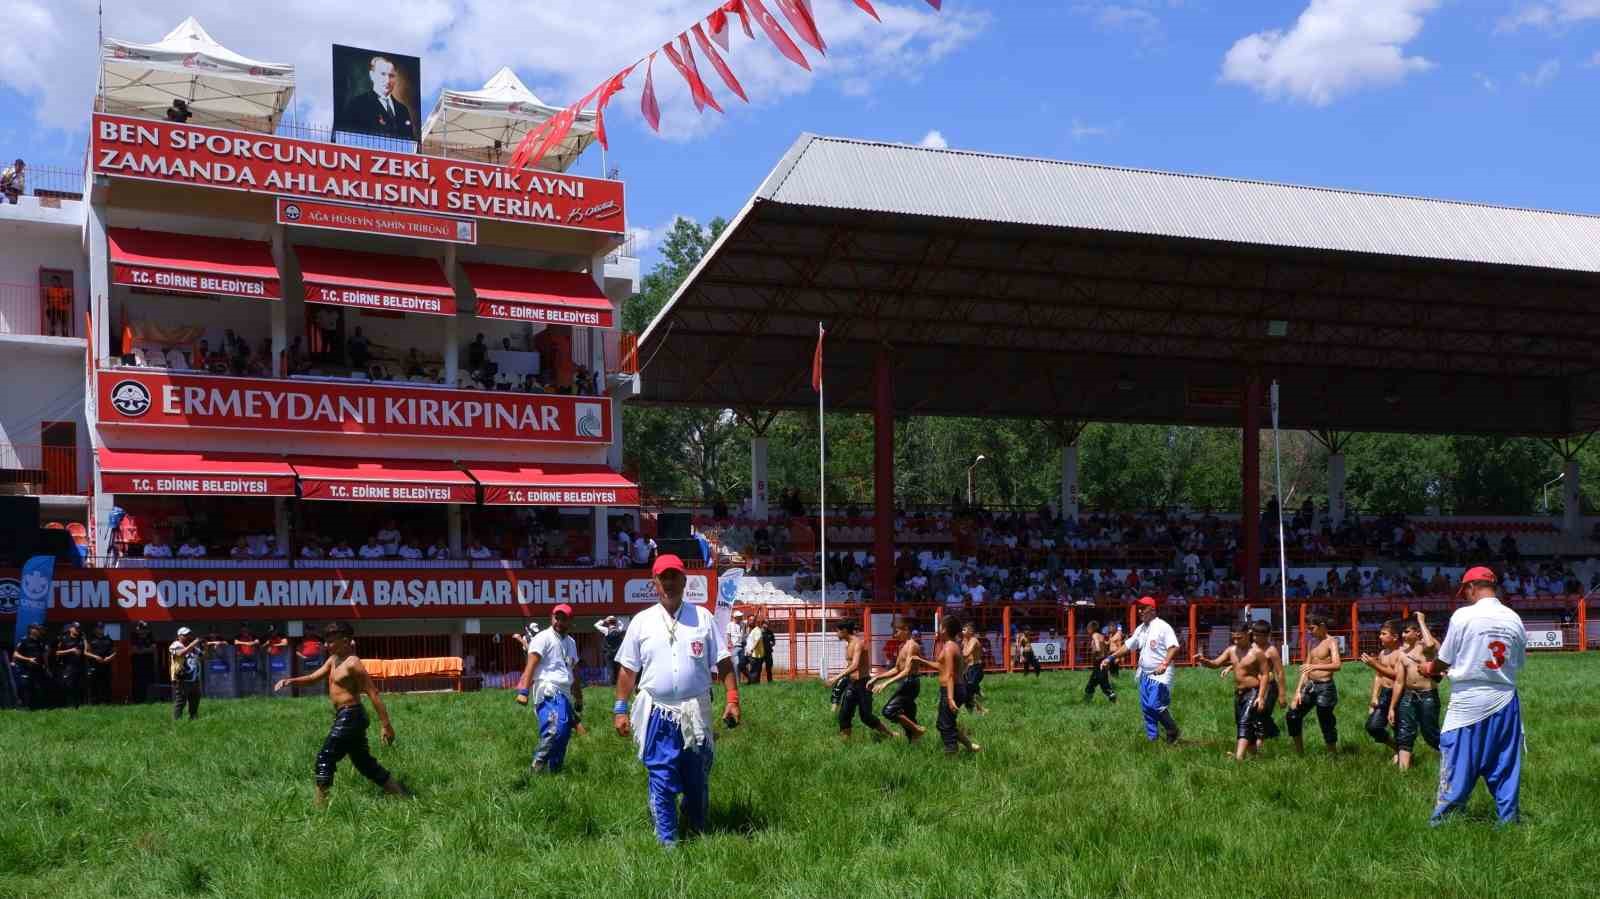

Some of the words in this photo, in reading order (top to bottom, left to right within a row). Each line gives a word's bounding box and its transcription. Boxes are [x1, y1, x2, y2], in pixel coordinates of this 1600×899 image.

[99, 121, 160, 146] BEN
[169, 130, 361, 171] SPORCUNUN
[370, 156, 436, 185] ZEKİ,
[446, 166, 521, 191] ÇEVİK
[527, 176, 585, 198] AYNI
[99, 149, 257, 185] ZAMANDA
[264, 170, 438, 207] AHLAKLISINI
[447, 191, 562, 221] SEVERİM.
[131, 270, 152, 284] T.C.
[155, 271, 197, 289] EDİRNE
[200, 275, 264, 295] BELEDİYESİ
[320, 288, 340, 302] T.C.
[342, 289, 380, 306] EDİRNE
[383, 295, 441, 312] BELEDİYESİ
[491, 304, 508, 317] T.C.
[510, 305, 545, 320] EDİRNE
[547, 309, 599, 325] BELEDİYESİ
[161, 384, 376, 424] ERMEYDANI
[384, 397, 561, 432] KIRKPINAR
[132, 480, 153, 491] T.C.
[156, 477, 198, 492] EDİRNE
[202, 478, 267, 493] BELEDİYESİ
[330, 485, 349, 497] T.C.
[352, 484, 390, 499] EDİRNE
[393, 486, 450, 500] BELEDİYESİ
[508, 490, 525, 502] T.C.
[528, 489, 561, 502] EDİRNE
[563, 489, 616, 503] BELEDİYESİ
[117, 579, 368, 608] SPORCULARIMIZA
[373, 579, 513, 608] BAŞARILAR
[517, 578, 613, 605] DİLERİM
[1486, 640, 1506, 669] 3
